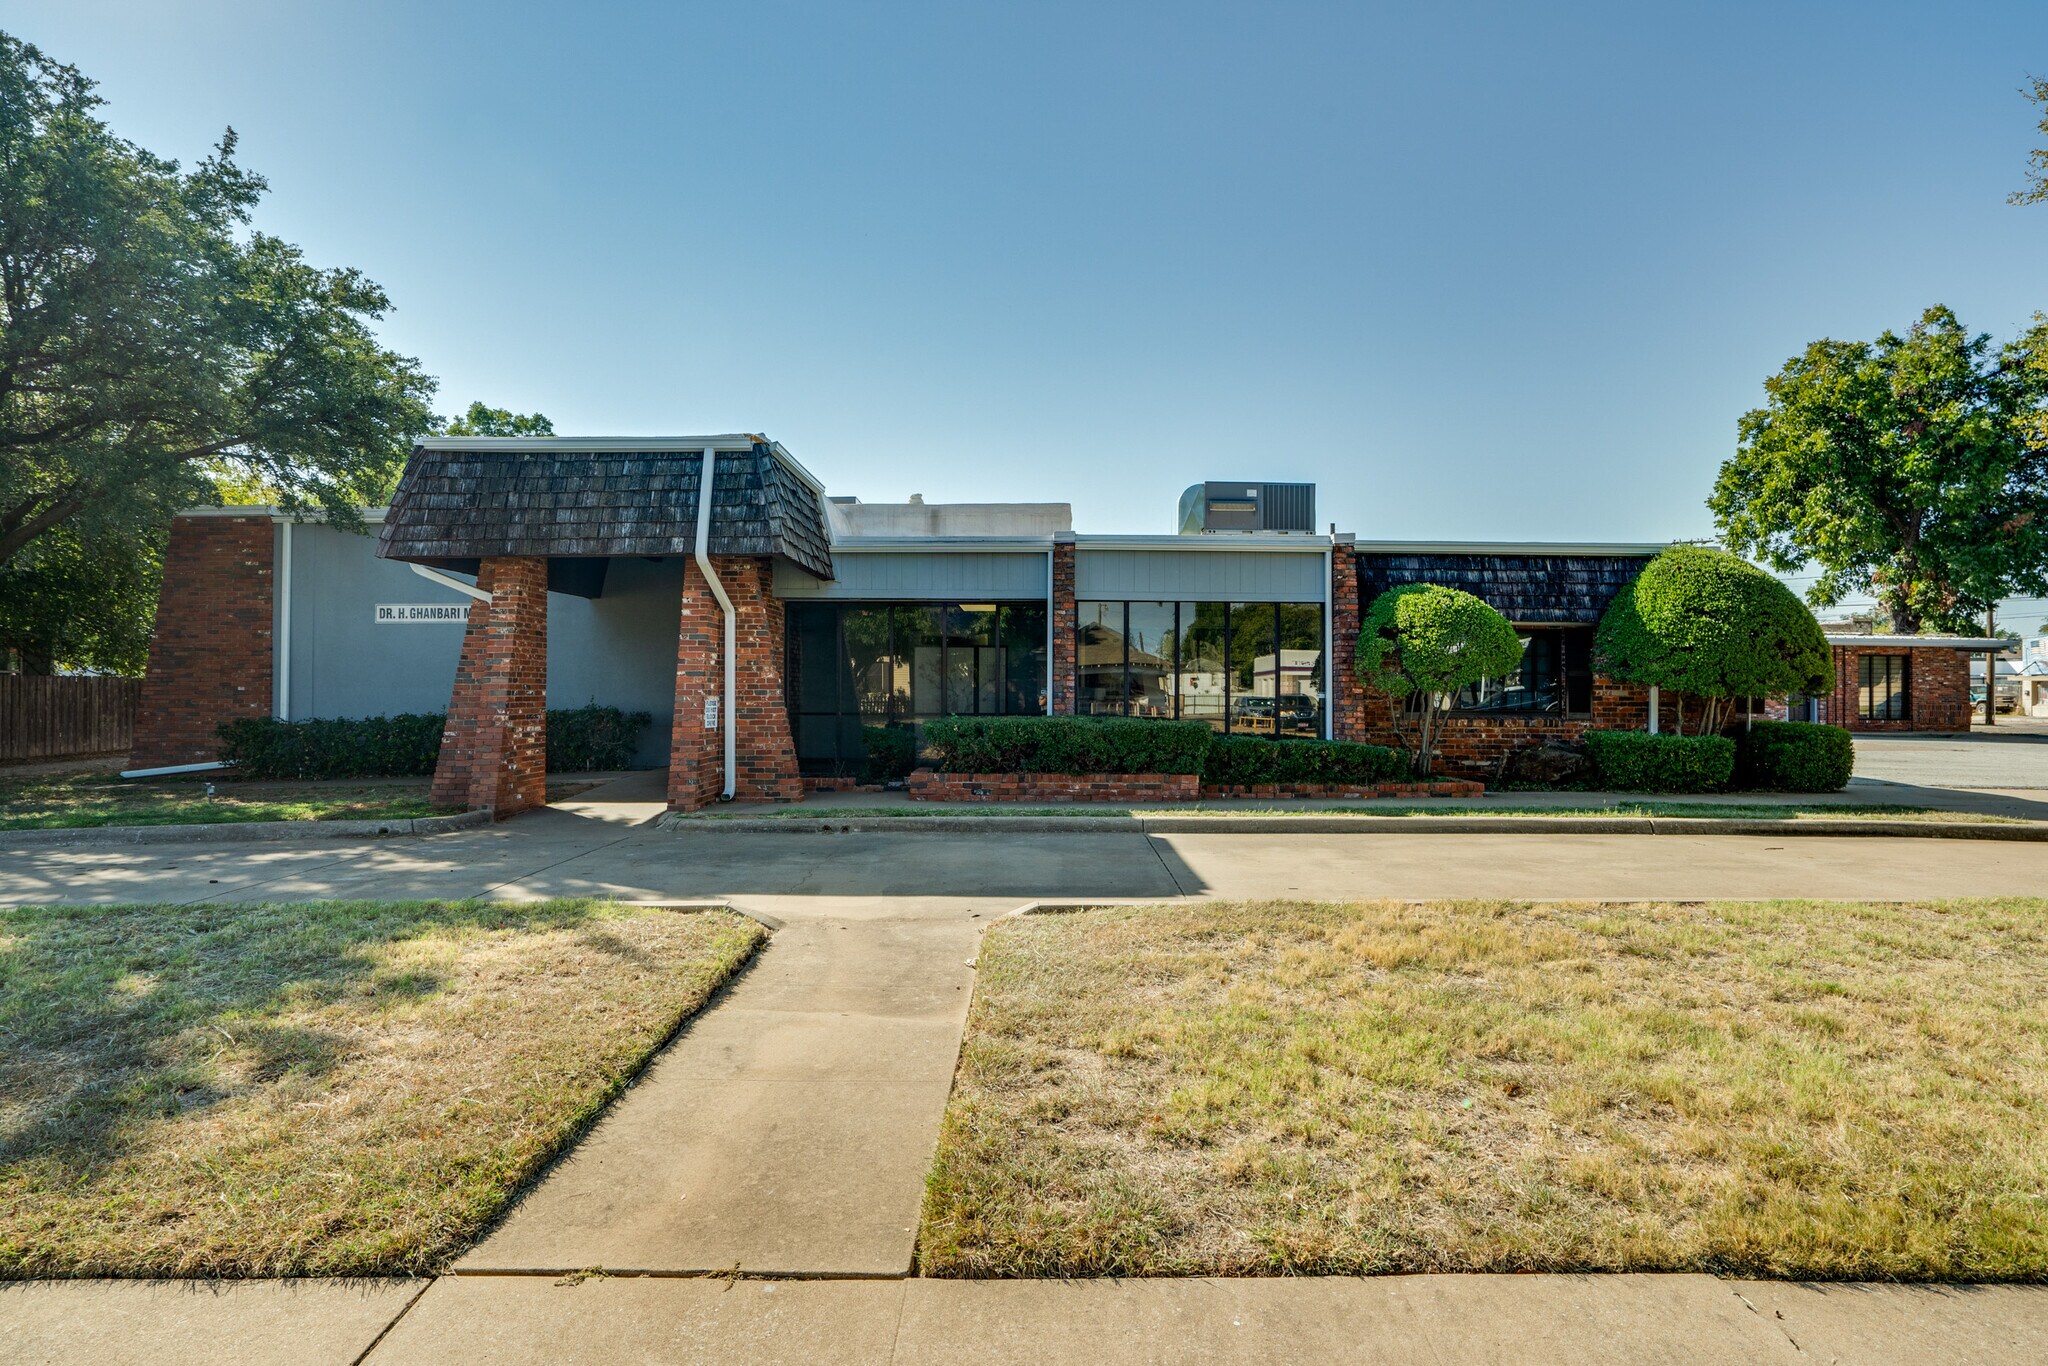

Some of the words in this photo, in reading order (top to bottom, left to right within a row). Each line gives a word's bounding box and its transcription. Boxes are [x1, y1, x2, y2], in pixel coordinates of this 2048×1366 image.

[379, 607, 396, 619] DR.
[398, 607, 408, 619] H.
[410, 607, 460, 619] GHANBARI
